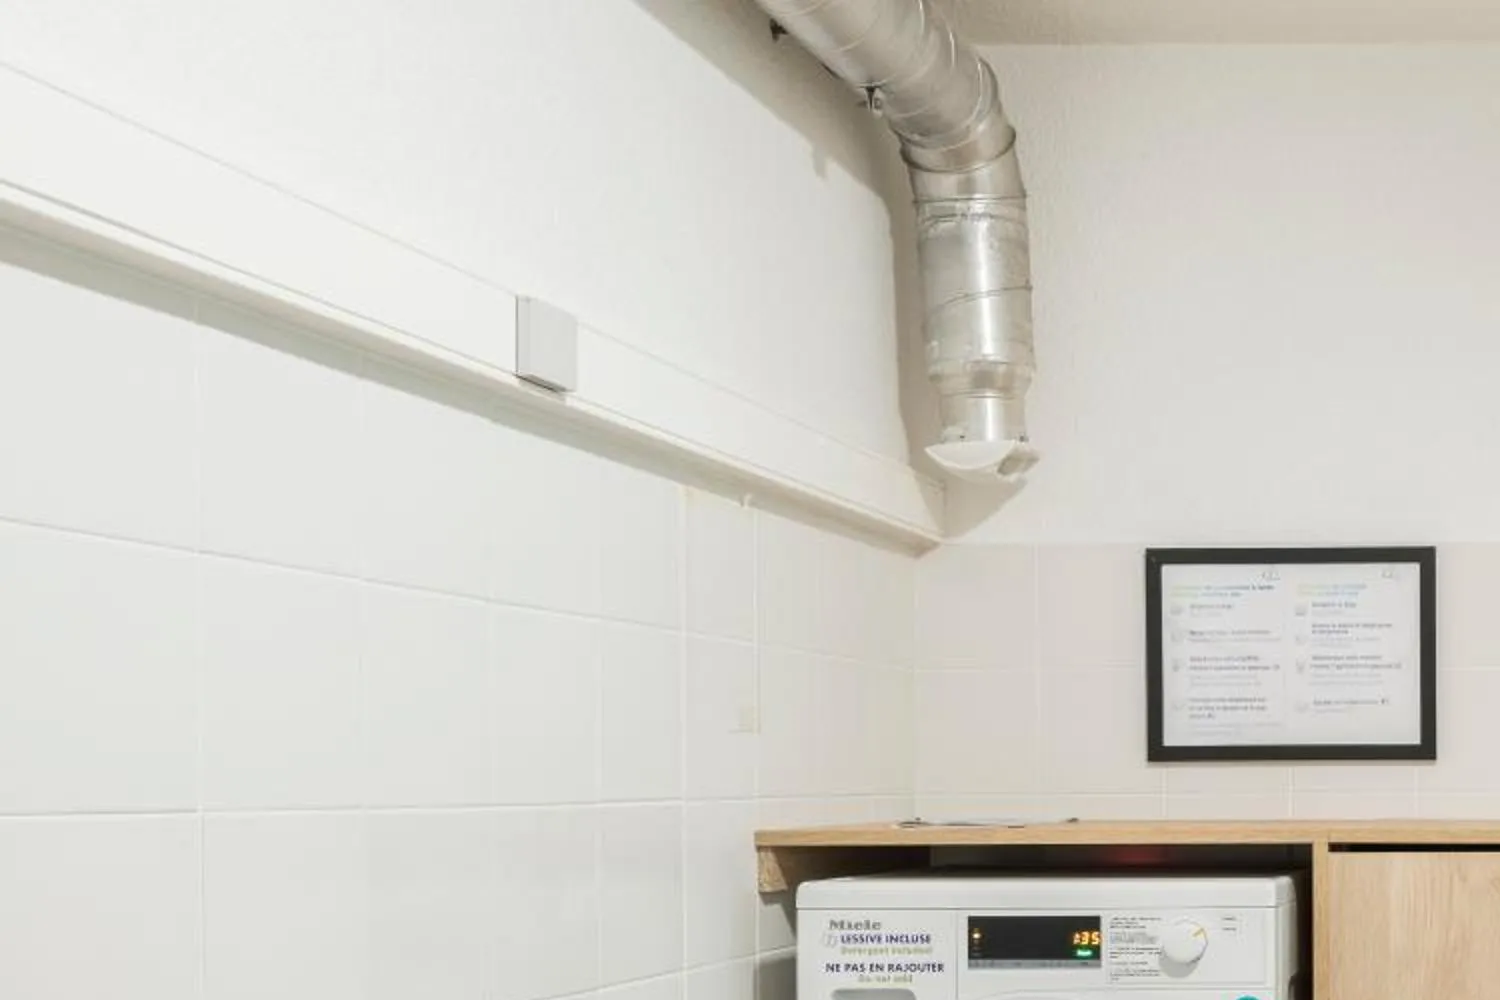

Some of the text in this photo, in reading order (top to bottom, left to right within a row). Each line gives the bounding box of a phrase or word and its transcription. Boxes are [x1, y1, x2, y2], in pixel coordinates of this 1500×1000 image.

[828, 919, 881, 930] Miele
[840, 933, 931, 944] LESSIVE INCLUSE
[825, 963, 945, 973] NE PAS EN RAJOUTER
